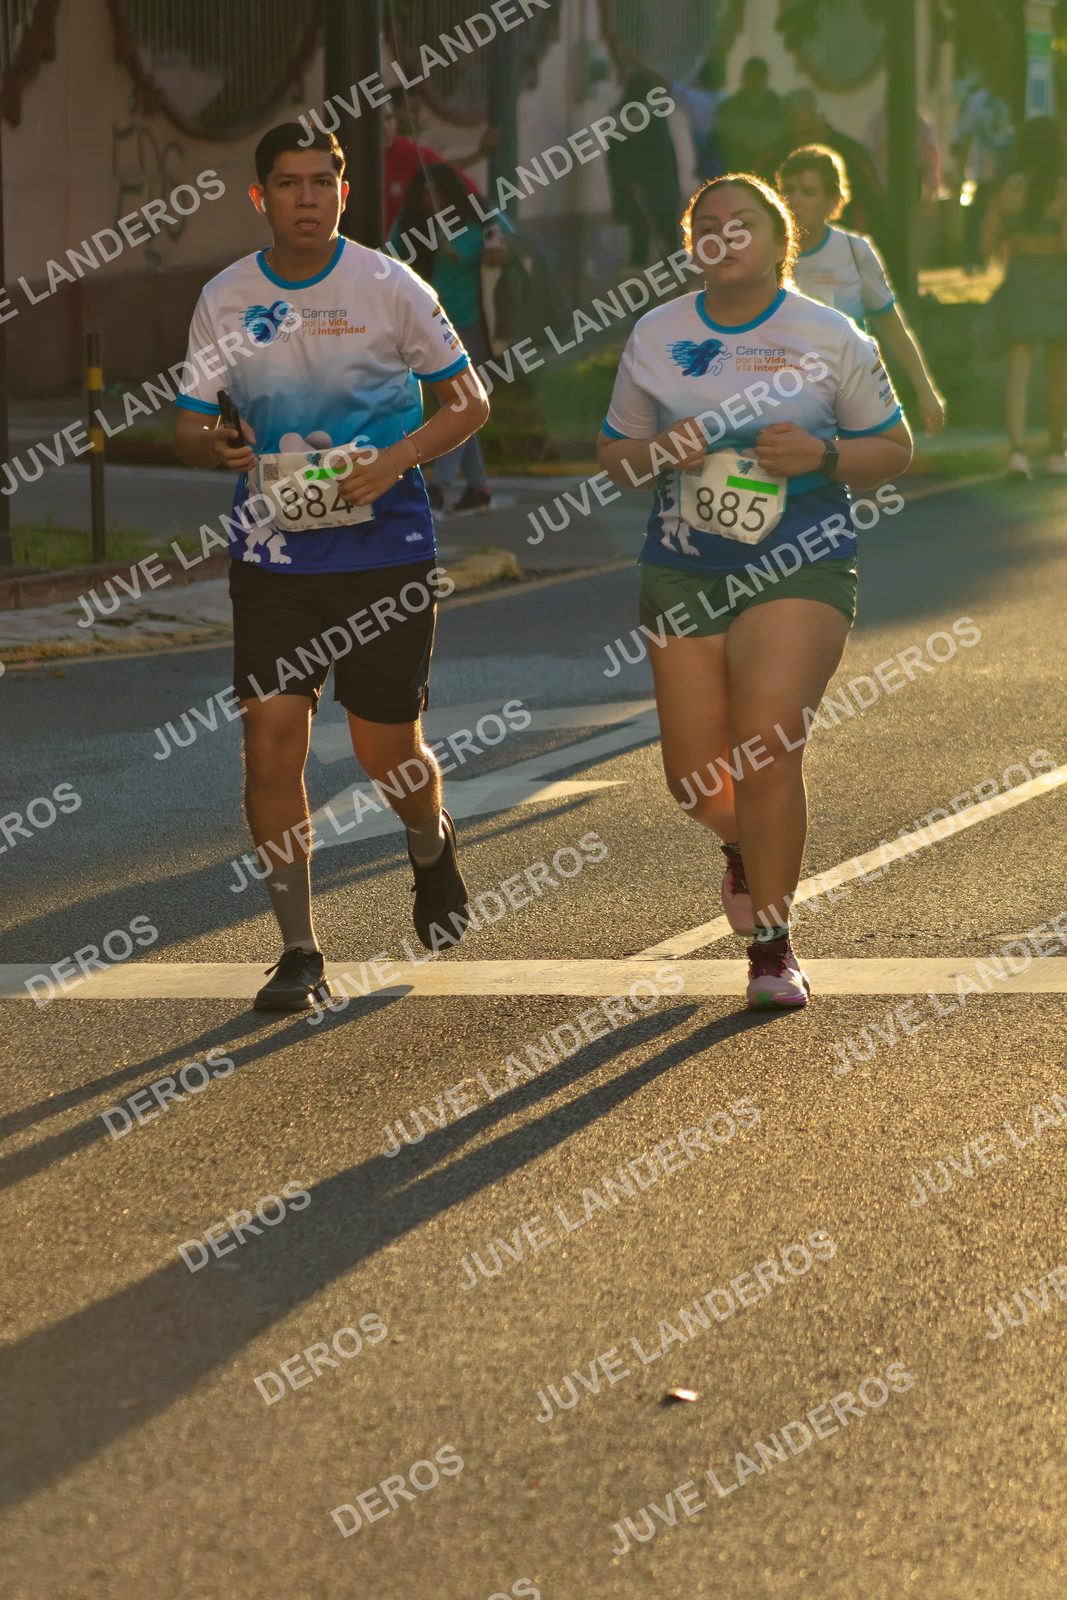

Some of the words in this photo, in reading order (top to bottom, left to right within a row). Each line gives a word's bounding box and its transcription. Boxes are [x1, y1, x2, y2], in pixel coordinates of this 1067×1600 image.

[302, 308, 347, 319] Carrera
[328, 318, 348, 327] Vida
[318, 325, 366, 336] Integridad
[736, 346, 785, 356] Carrera
[765, 356, 787, 364] Vida
[280, 485, 354, 521] 884
[696, 487, 768, 532] 885
